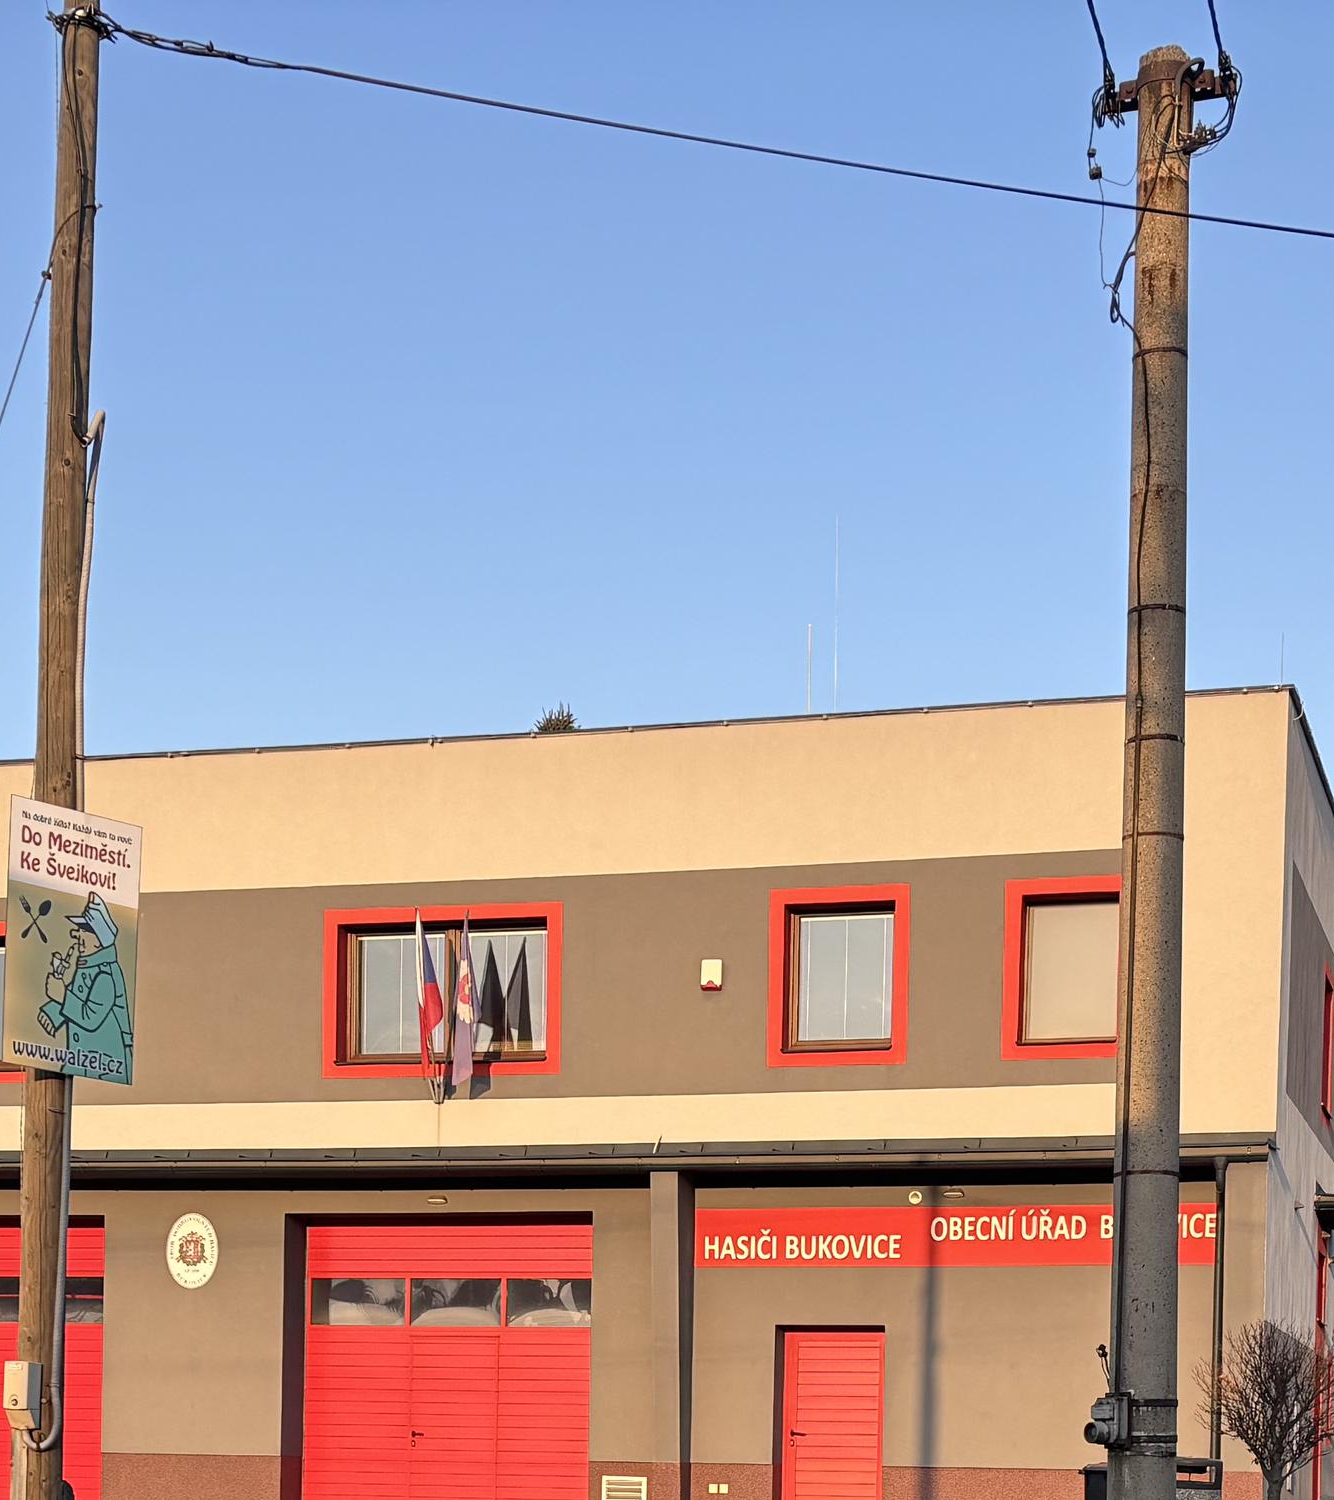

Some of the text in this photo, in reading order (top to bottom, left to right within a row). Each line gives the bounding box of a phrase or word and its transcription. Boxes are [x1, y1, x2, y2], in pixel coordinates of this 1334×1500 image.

[21, 824, 132, 869] Do Meziměstí.
[20, 850, 117, 891] Ke Švejkovi!
[12, 1040, 124, 1075] www.walzel.cz
[930, 1209, 1016, 1242] OBECNÍ
[1020, 1208, 1087, 1241] ÚŘAD
[703, 1228, 902, 1260] HASIČI BUKOVICE
